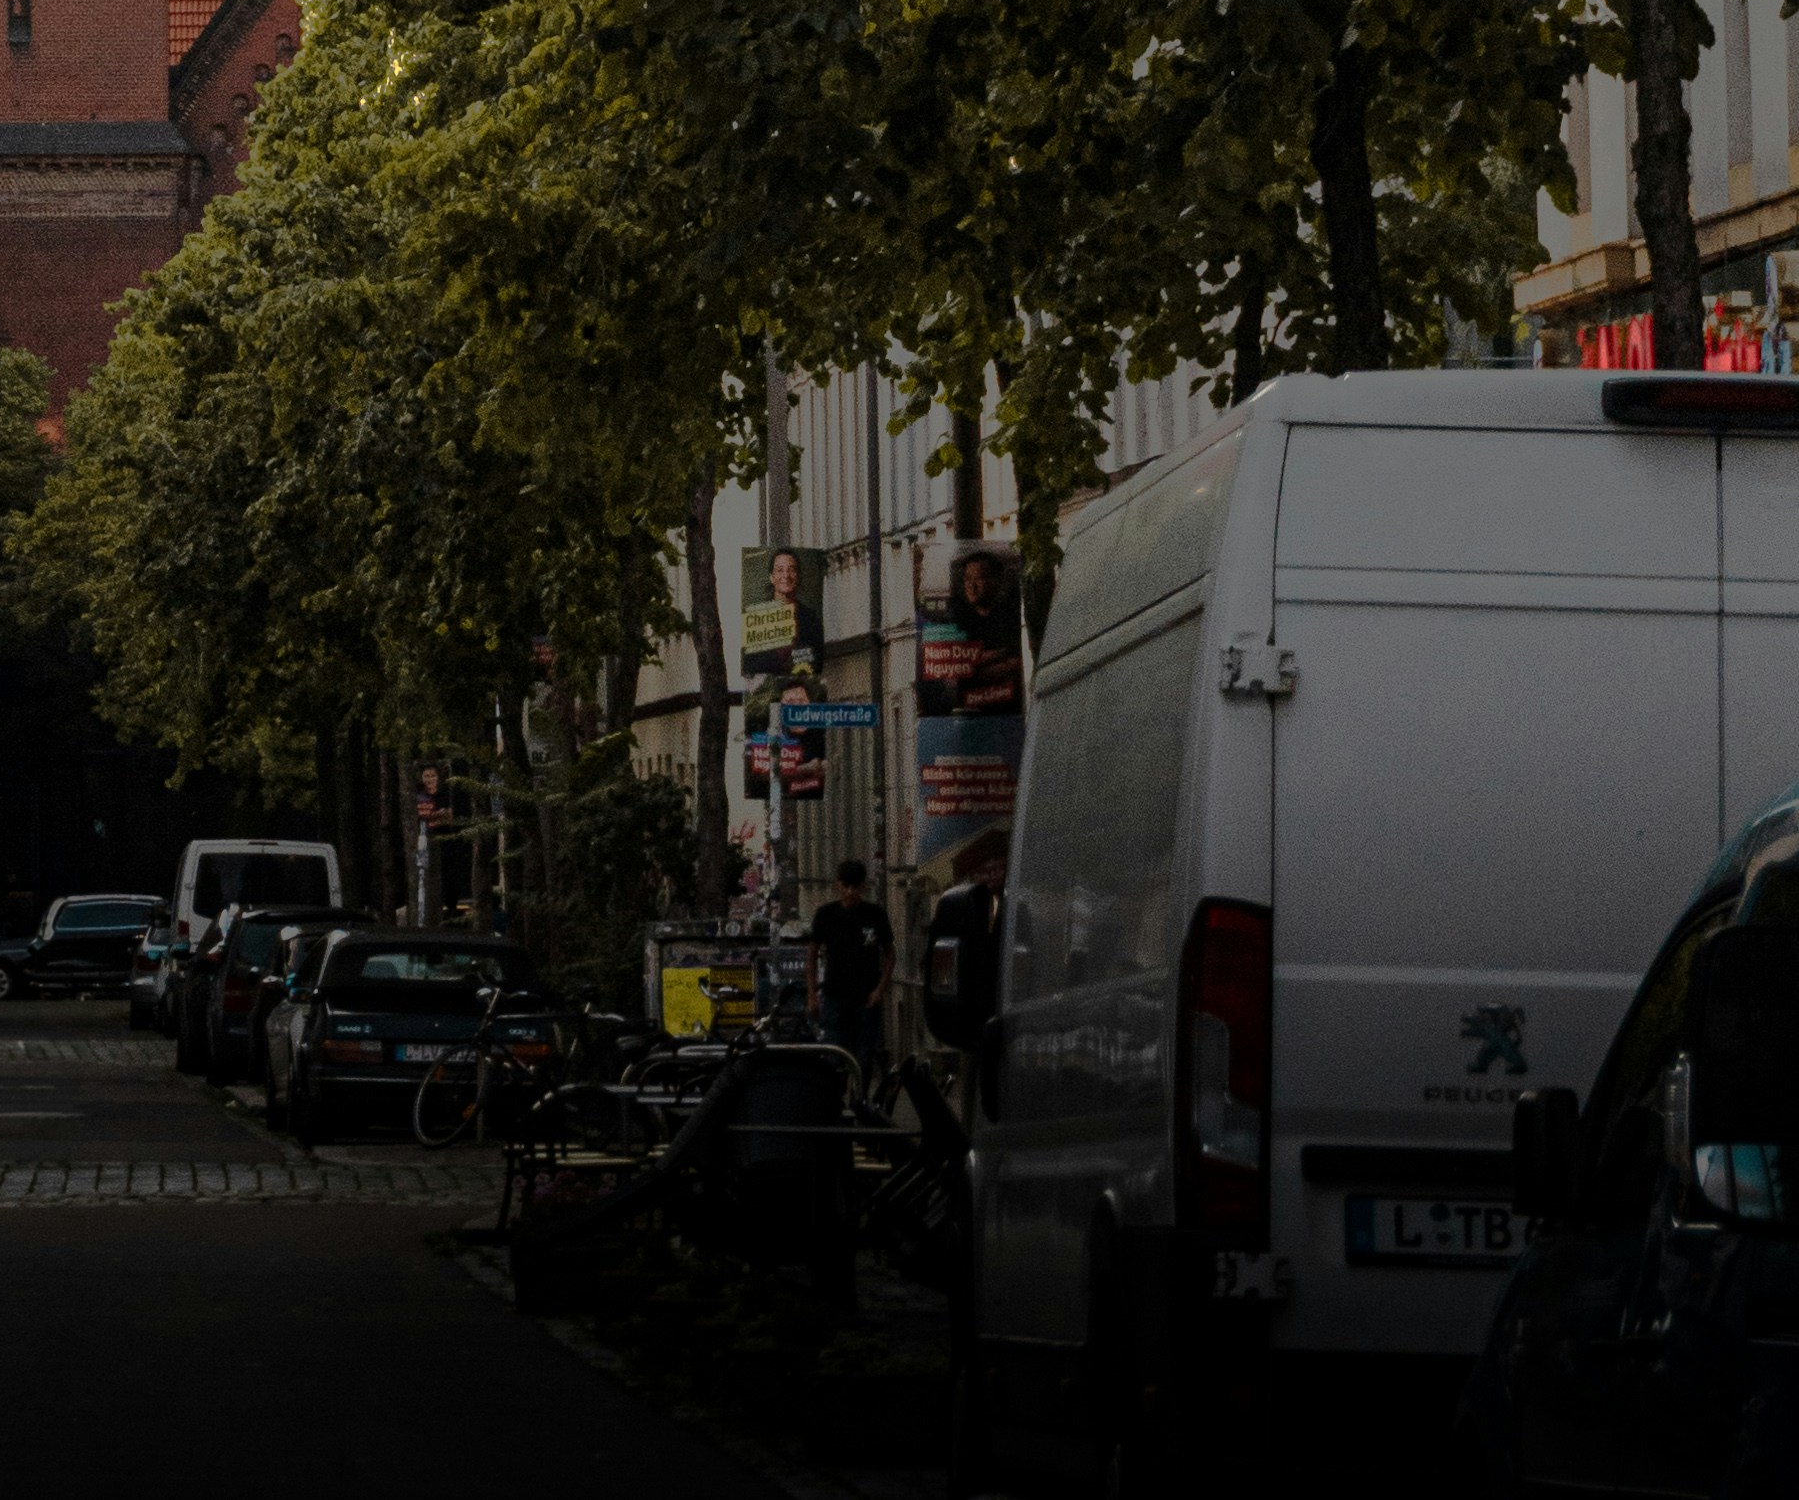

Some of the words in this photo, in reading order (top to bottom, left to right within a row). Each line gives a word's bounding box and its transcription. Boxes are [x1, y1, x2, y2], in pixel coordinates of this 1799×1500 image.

[745, 609, 793, 629] Christin
[924, 646, 951, 660] Nam
[952, 644, 980, 661] Duy
[924, 661, 972, 679] Nguyen
[787, 706, 872, 725] Ludwigstraße
[781, 747, 801, 761] Duy
[753, 760, 797, 773] Ngen
[1422, 1087, 1521, 1103] PEUGE
[1394, 1204, 1422, 1247] L
[1454, 1206, 1512, 1250] TB
